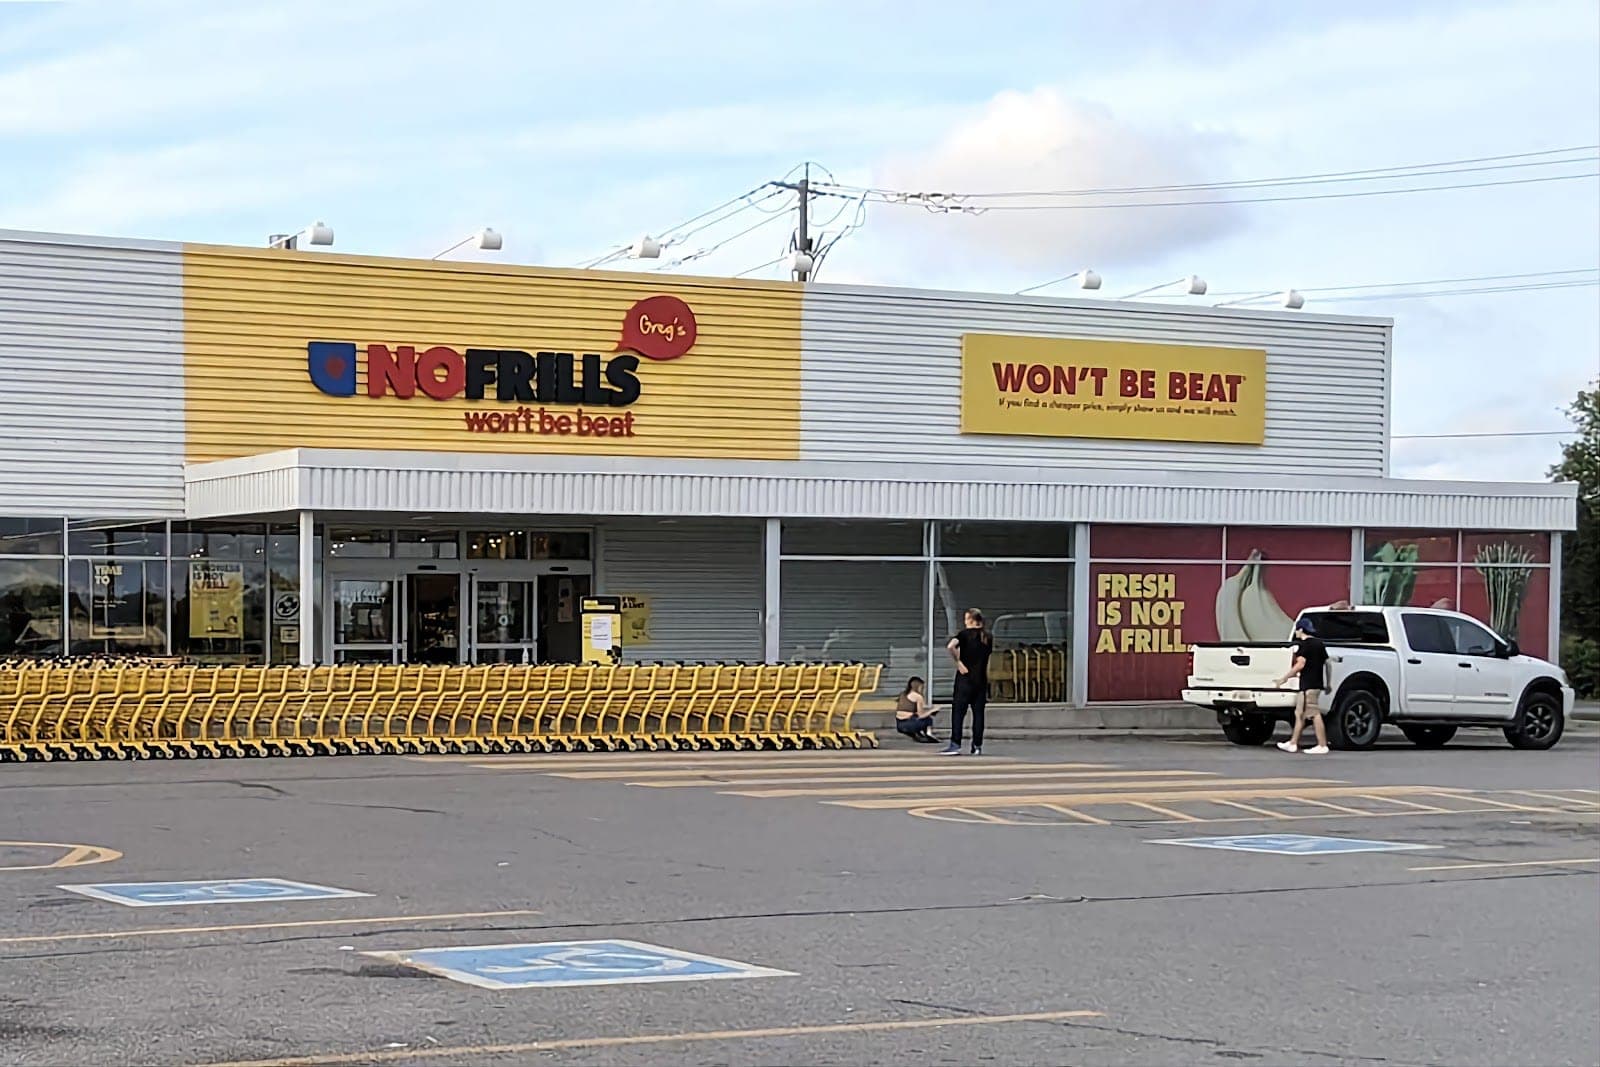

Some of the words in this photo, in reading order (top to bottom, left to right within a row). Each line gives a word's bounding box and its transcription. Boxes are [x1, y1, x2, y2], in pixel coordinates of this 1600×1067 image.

[640, 314, 686, 342] Greg's
[992, 362, 1108, 397] WON'T
[1119, 369, 1156, 399] BE
[1168, 372, 1242, 403] BEAT
[464, 405, 534, 433] won't
[539, 406, 572, 435] be
[577, 408, 635, 437] beat
[94, 575, 110, 585] TO
[1097, 573, 1176, 599] FRESH
[1097, 601, 1122, 626] IS
[1131, 601, 1185, 626] NOT
[1095, 629, 1116, 653] A
